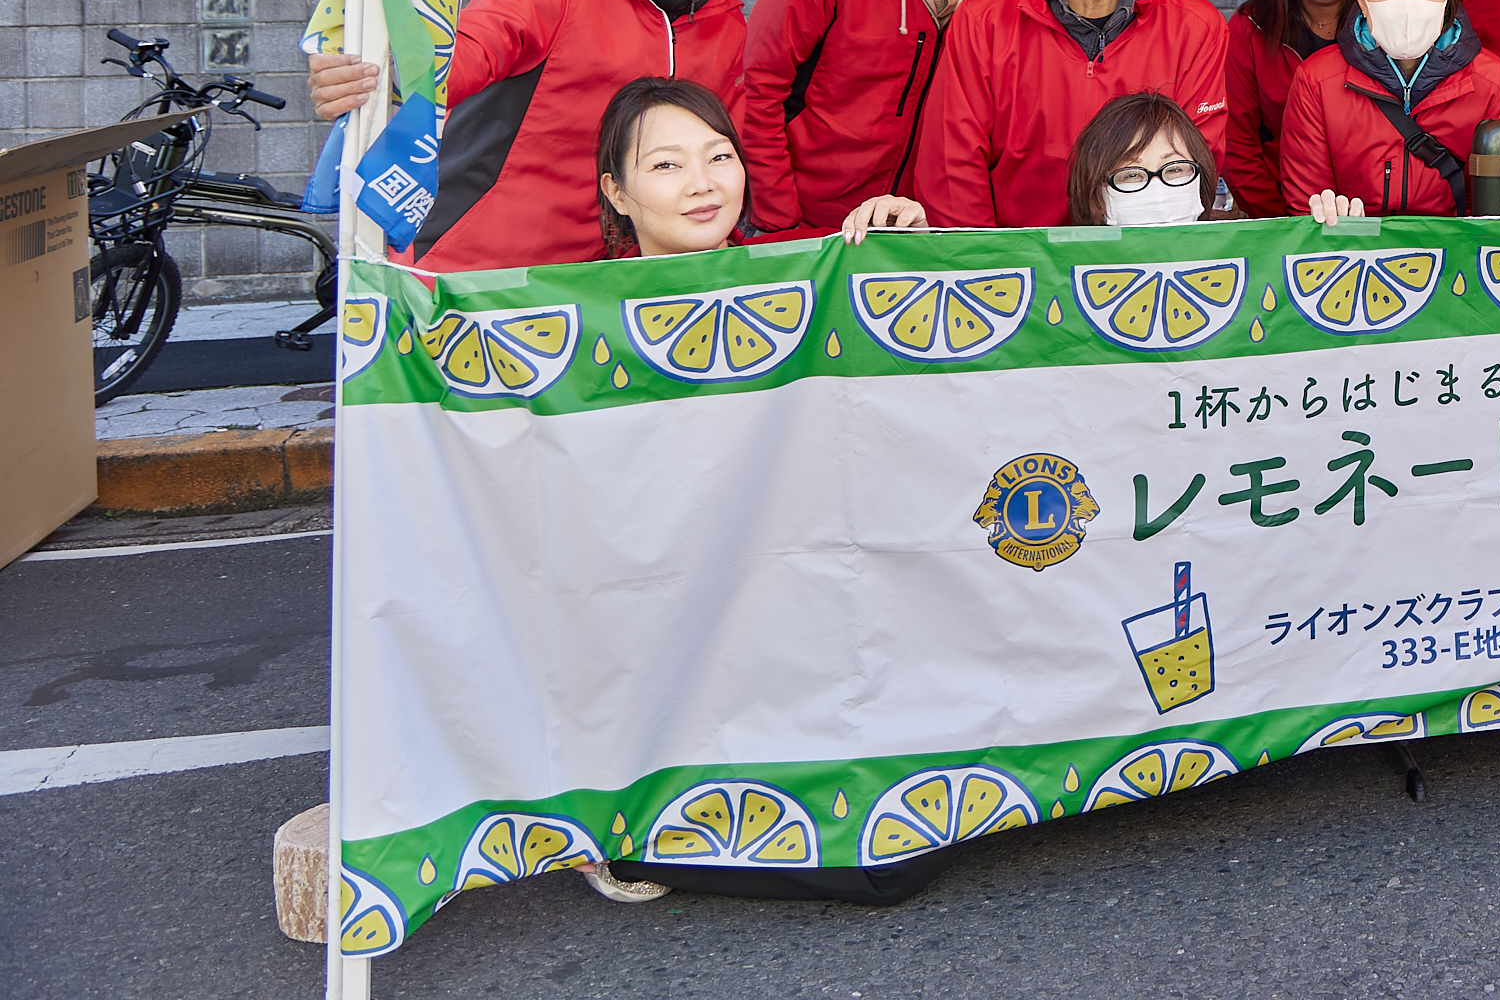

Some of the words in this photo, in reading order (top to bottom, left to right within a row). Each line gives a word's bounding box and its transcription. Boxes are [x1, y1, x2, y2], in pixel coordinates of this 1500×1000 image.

[1001, 458, 1072, 485] LIONS
[1024, 490, 1056, 530] L
[1003, 540, 1074, 561] INTERNATIONAL
